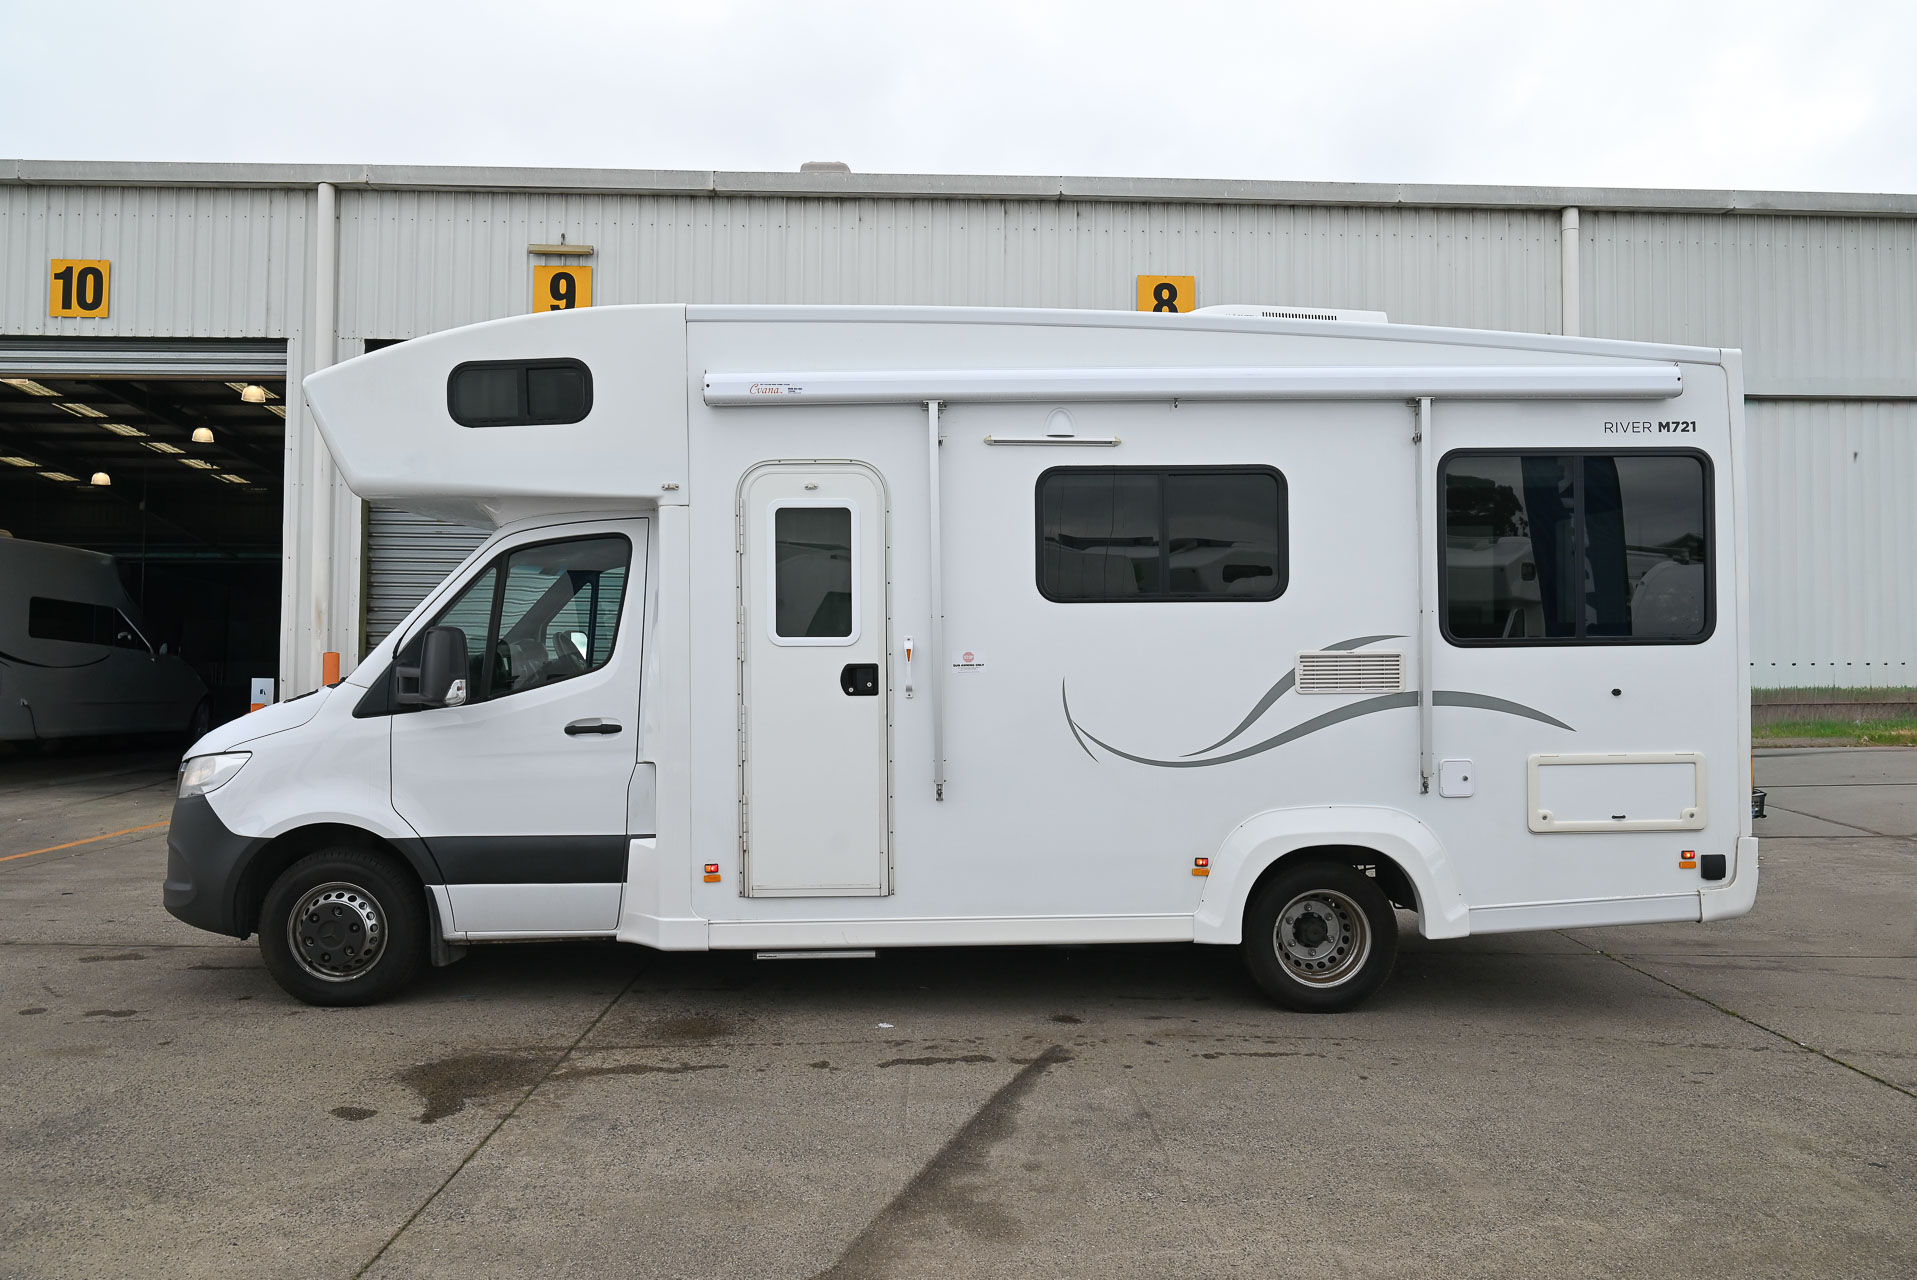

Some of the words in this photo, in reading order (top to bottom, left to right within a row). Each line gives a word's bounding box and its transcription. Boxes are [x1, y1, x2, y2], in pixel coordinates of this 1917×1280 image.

[54, 266, 104, 311] 10
[549, 271, 577, 312] 9
[1152, 282, 1179, 313] 8
[1604, 421, 1652, 433] RIVER
[1658, 421, 1696, 433] M721
